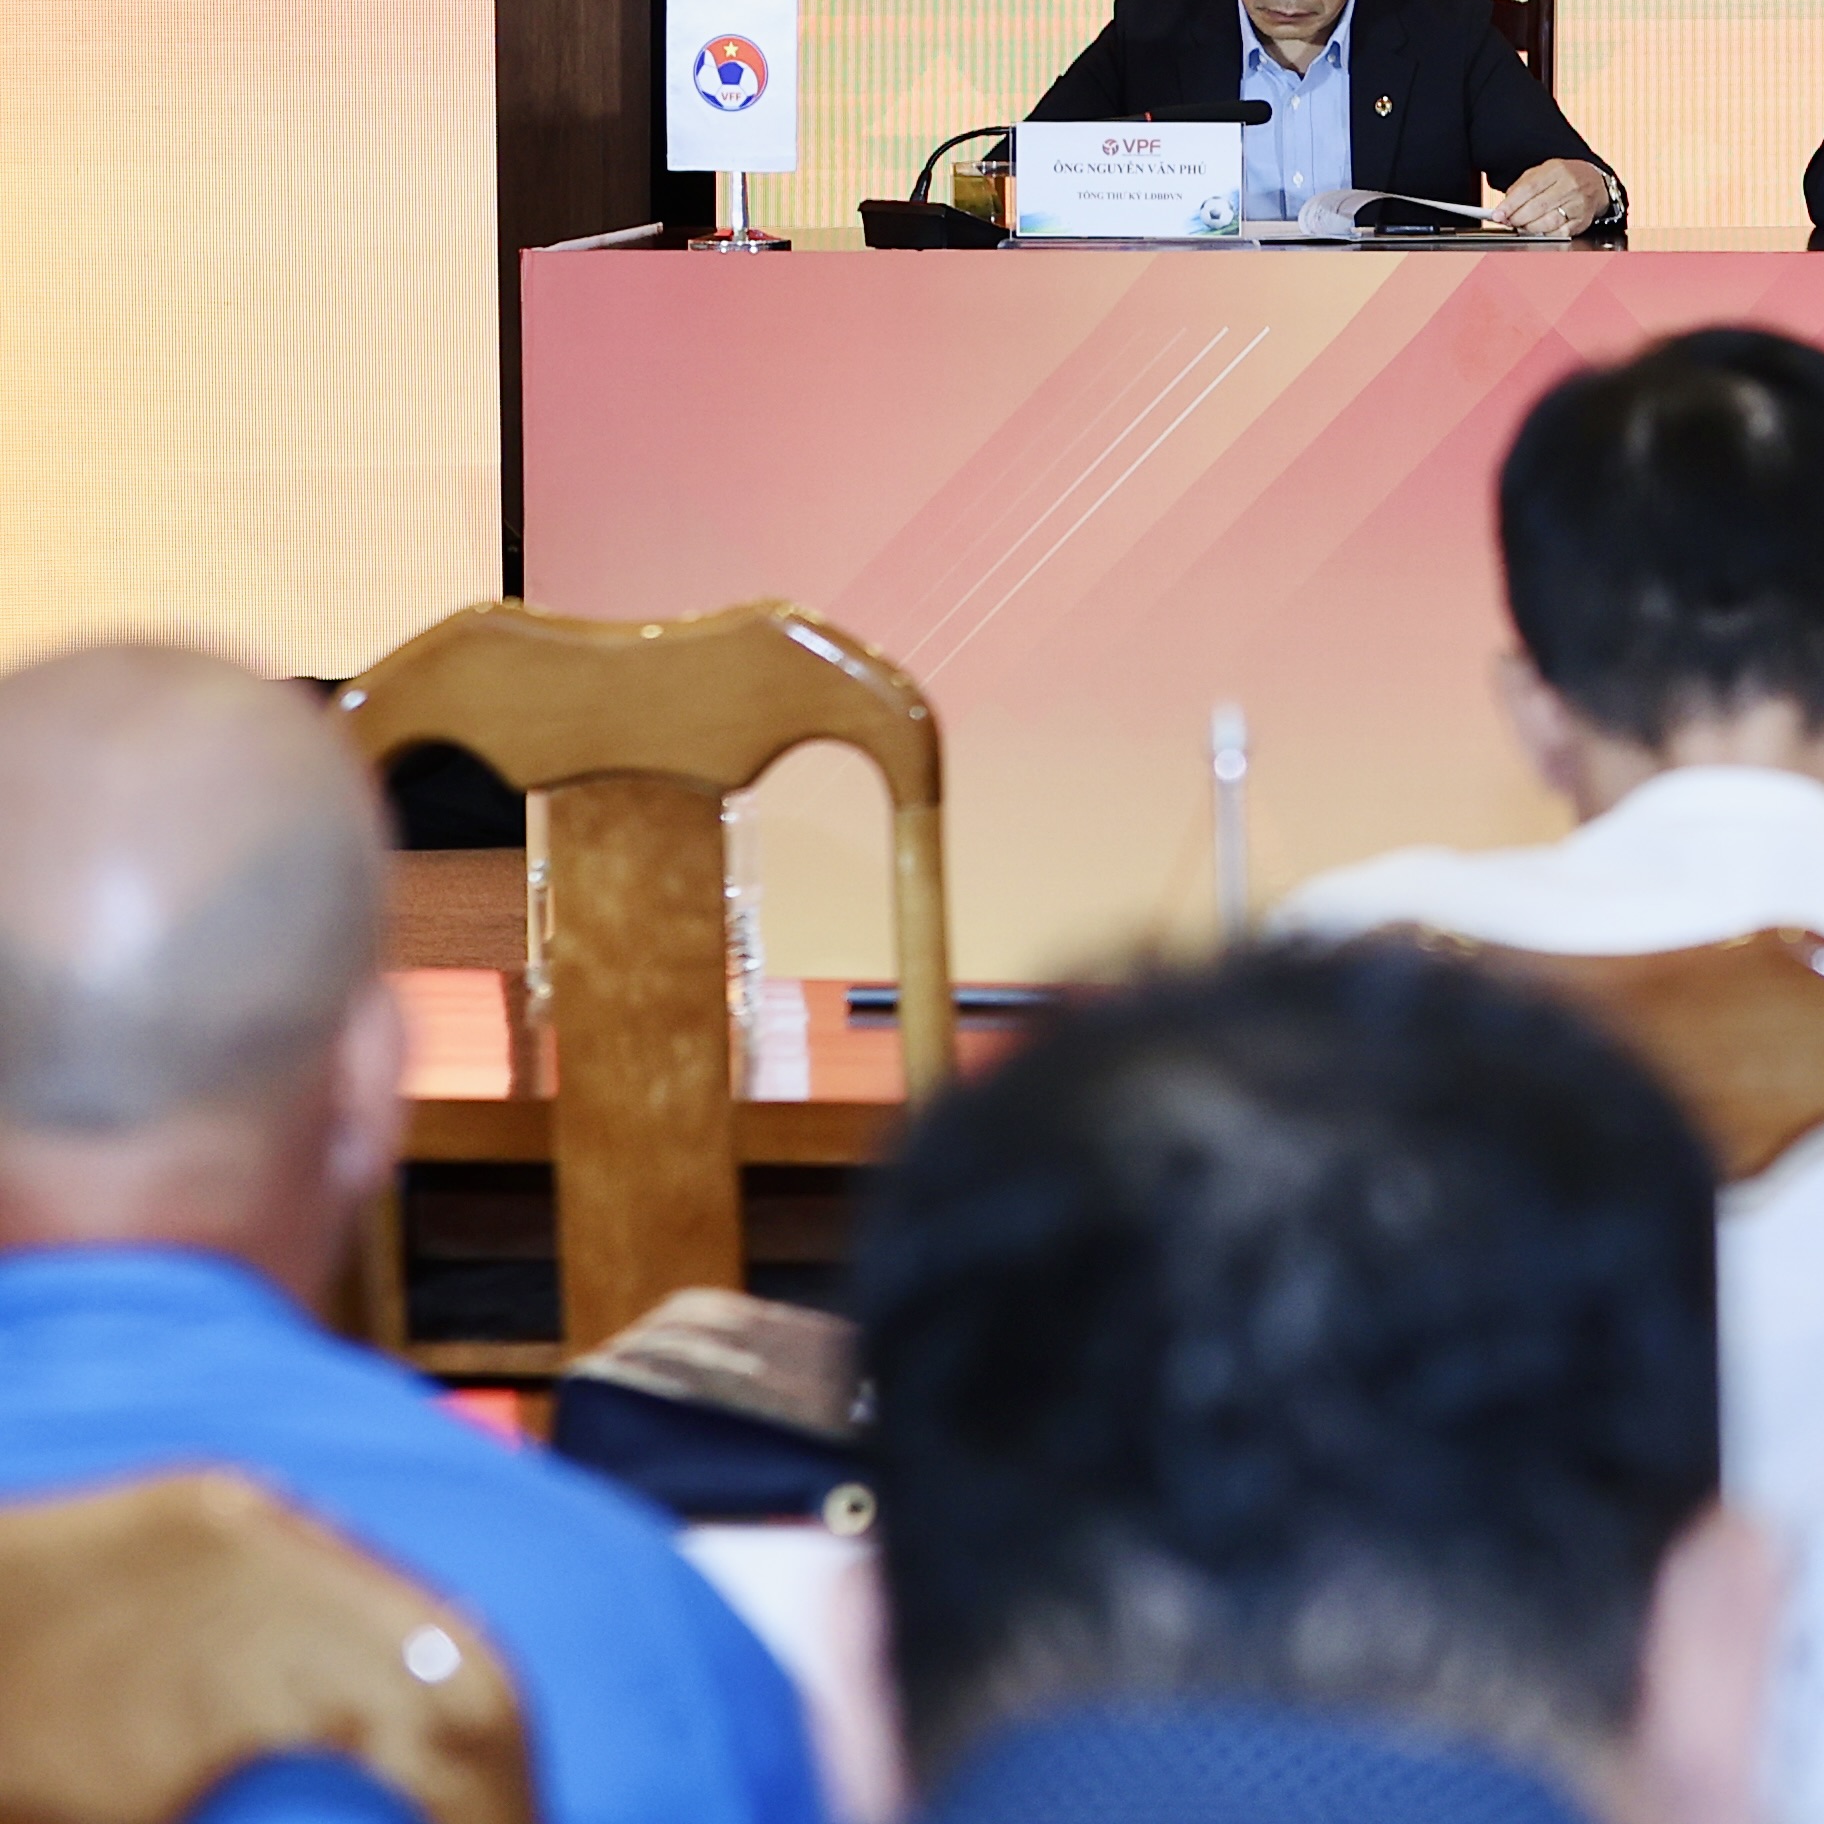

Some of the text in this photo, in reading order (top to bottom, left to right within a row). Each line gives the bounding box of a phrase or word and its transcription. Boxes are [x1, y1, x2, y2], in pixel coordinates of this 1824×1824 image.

[720, 92, 742, 101] VFF
[1122, 138, 1161, 154] VPF
[1053, 159, 1084, 174] ÔNG
[1148, 161, 1175, 175] VĂN
[1178, 161, 1207, 175] PHÚ
